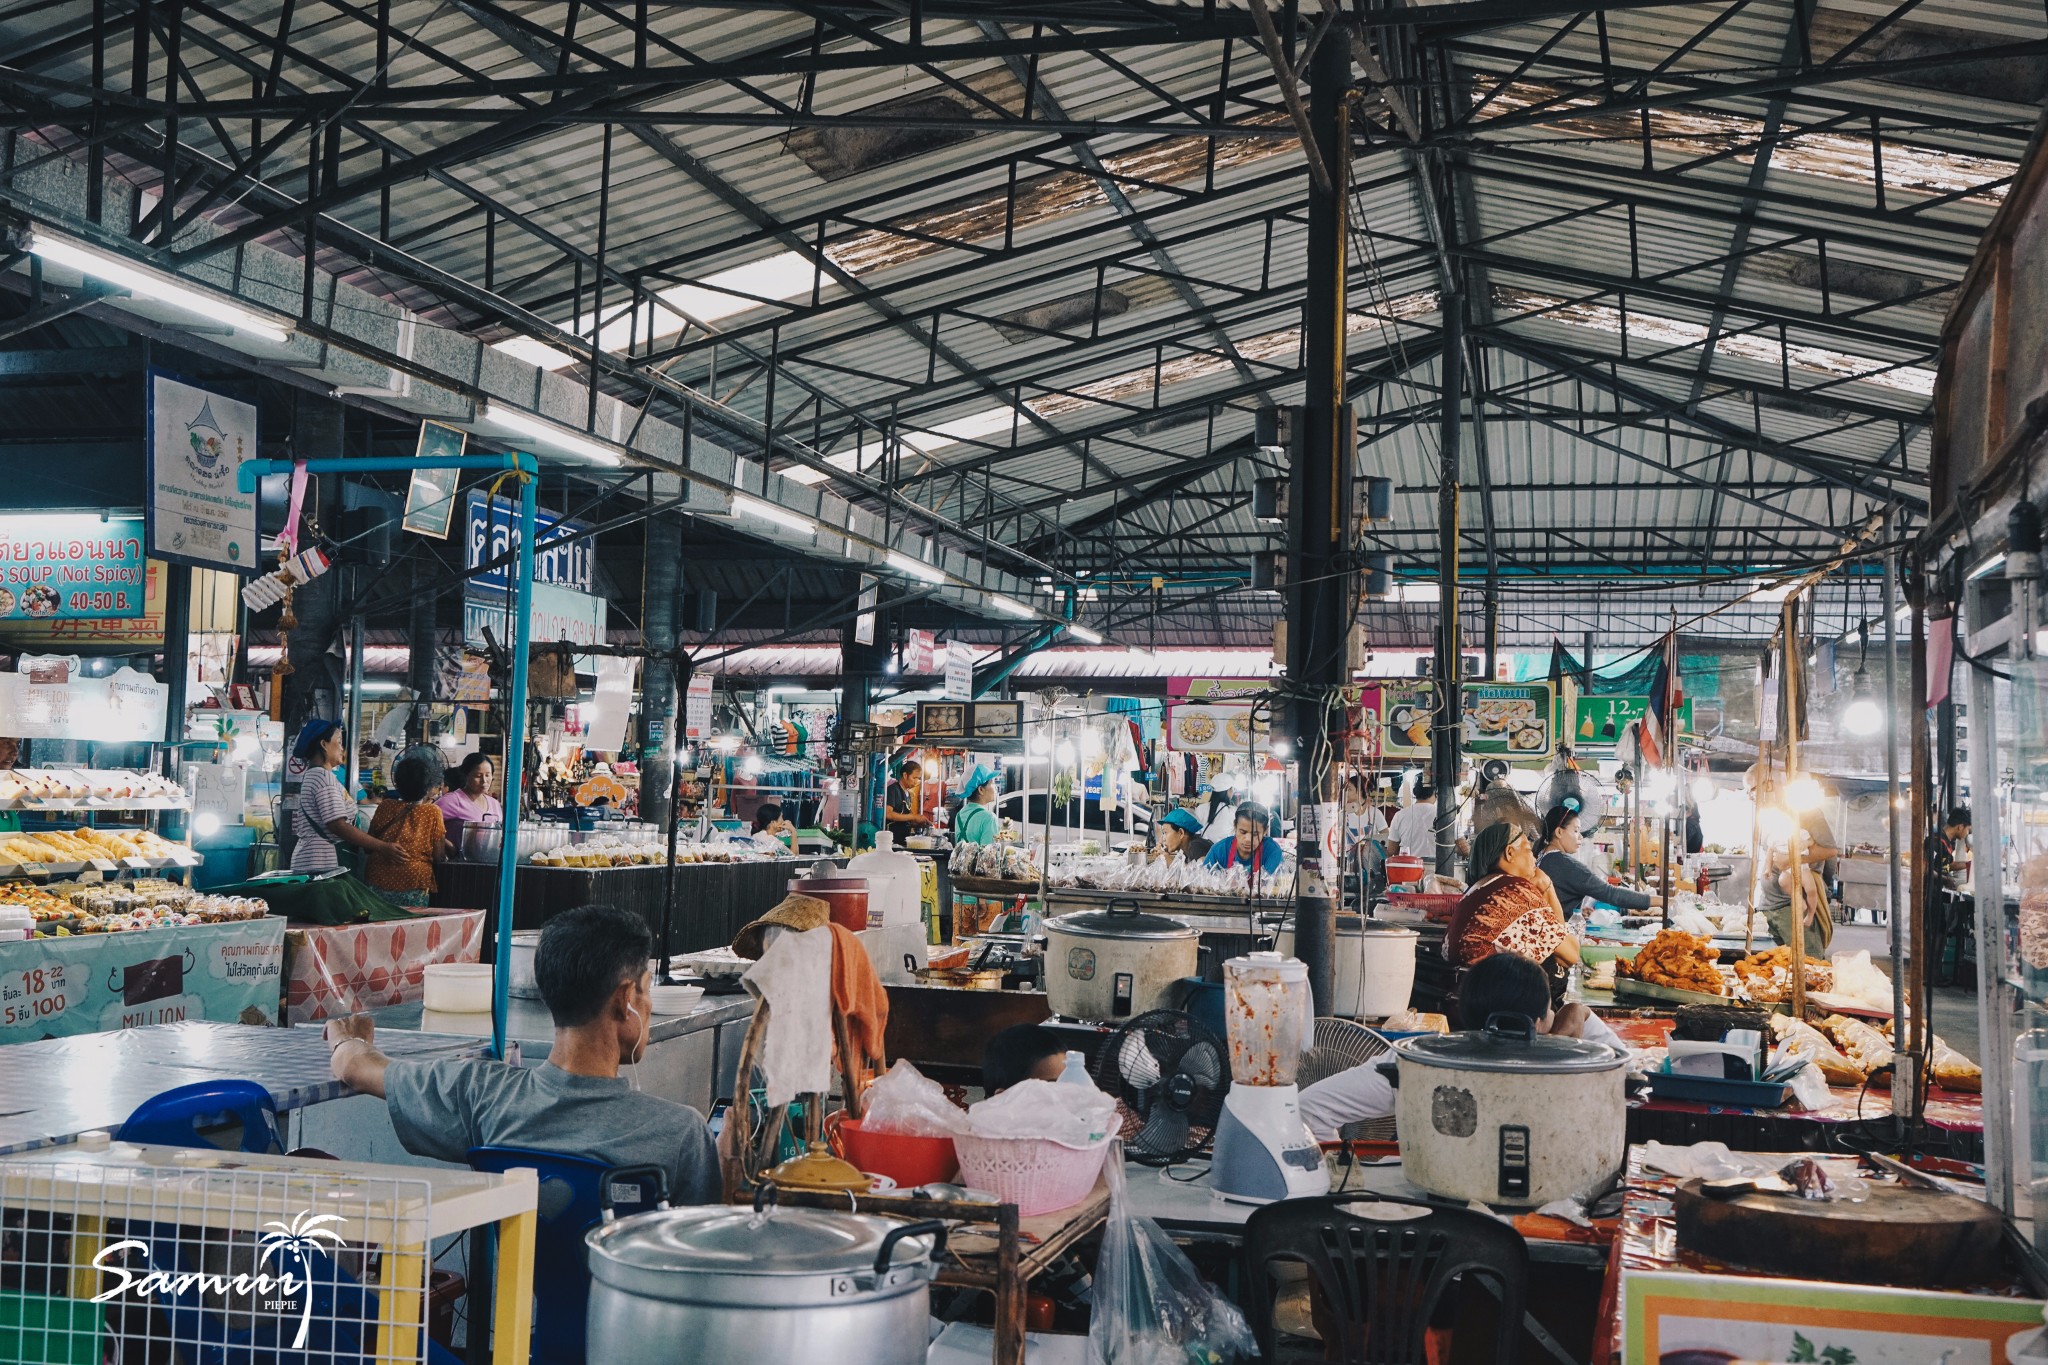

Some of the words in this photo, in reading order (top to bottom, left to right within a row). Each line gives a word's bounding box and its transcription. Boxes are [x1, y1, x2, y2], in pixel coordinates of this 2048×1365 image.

[9, 567, 53, 583] SOUP
[57, 565, 90, 586] (Not
[94, 564, 142, 586] Spicy)
[70, 592, 113, 610] 40-50
[116, 592, 130, 610] B.
[5, 1006, 16, 1025] 5
[32, 994, 66, 1017] 100
